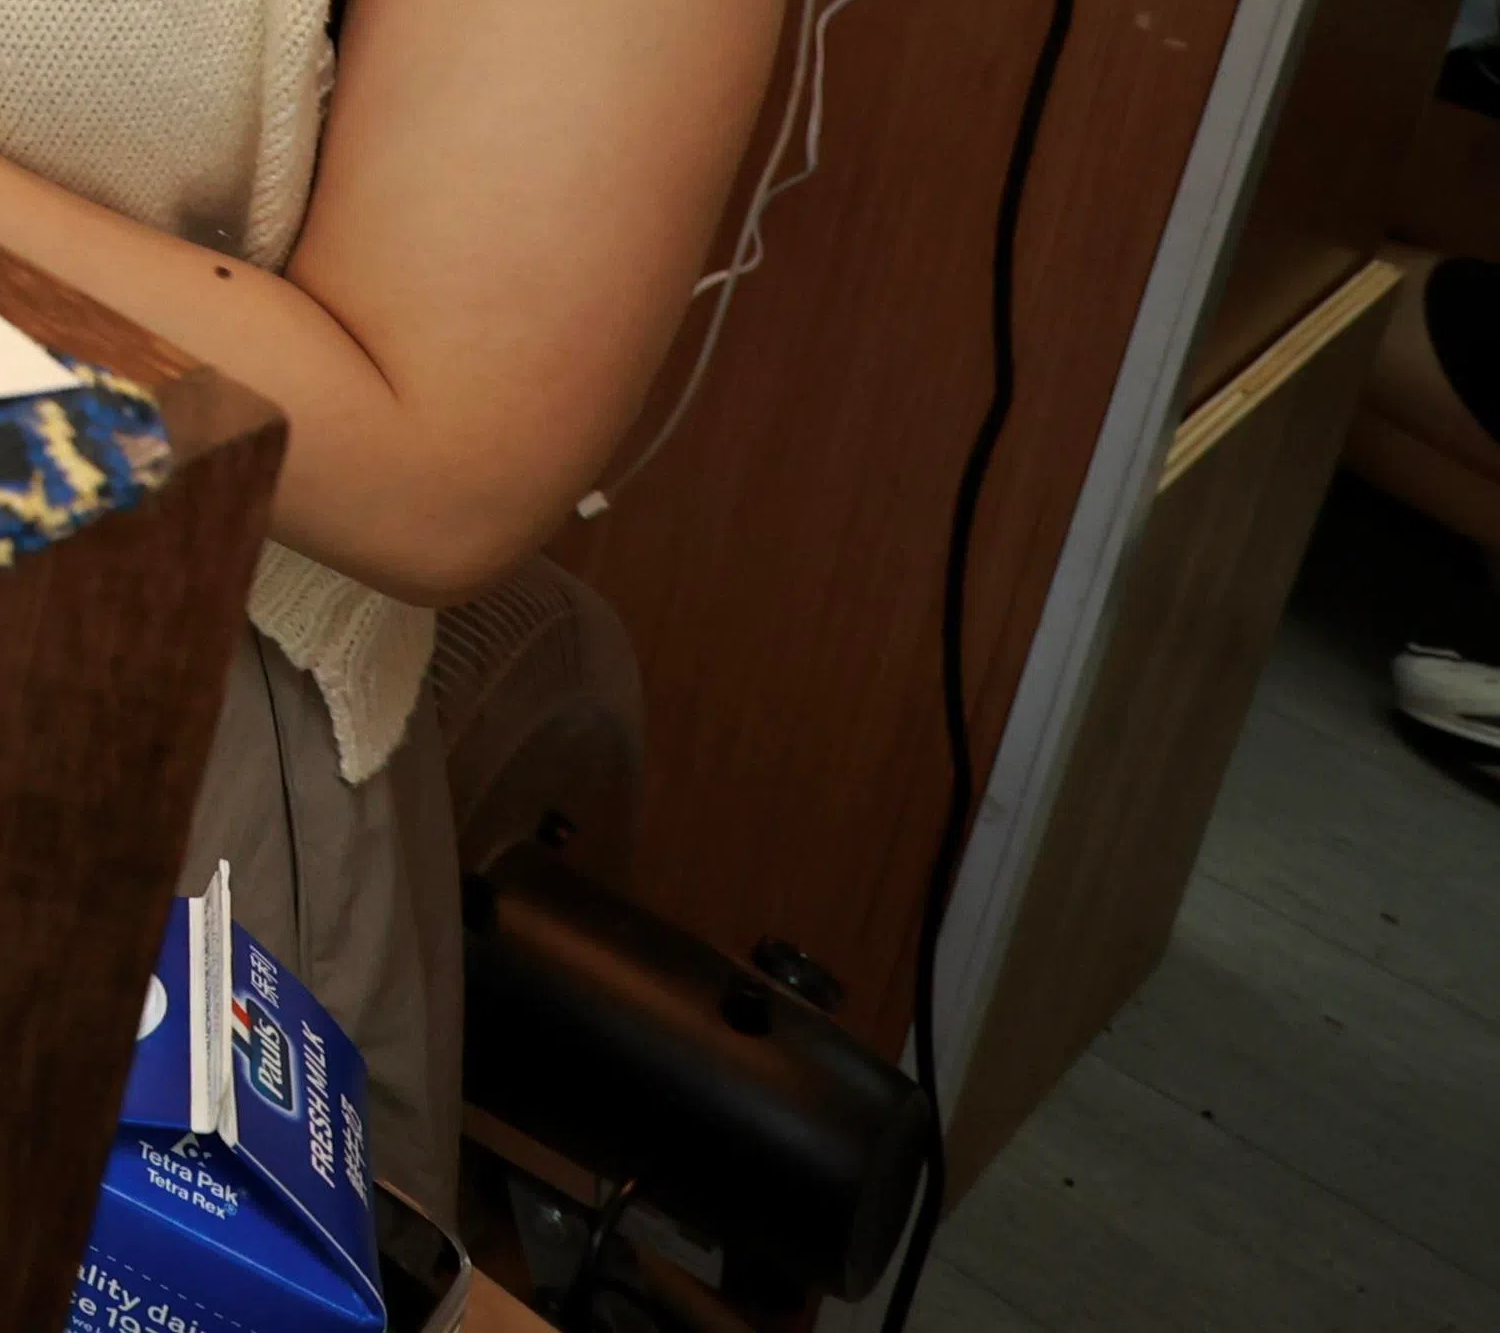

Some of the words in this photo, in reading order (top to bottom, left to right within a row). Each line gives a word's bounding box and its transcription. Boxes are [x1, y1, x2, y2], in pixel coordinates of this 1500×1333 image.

[253, 1017, 284, 1101] Pauls
[301, 1019, 330, 1100] MILK
[139, 1140, 193, 1183] Tetra
[307, 1086, 336, 1190] FRESH
[146, 1167, 189, 1201] Tetra
